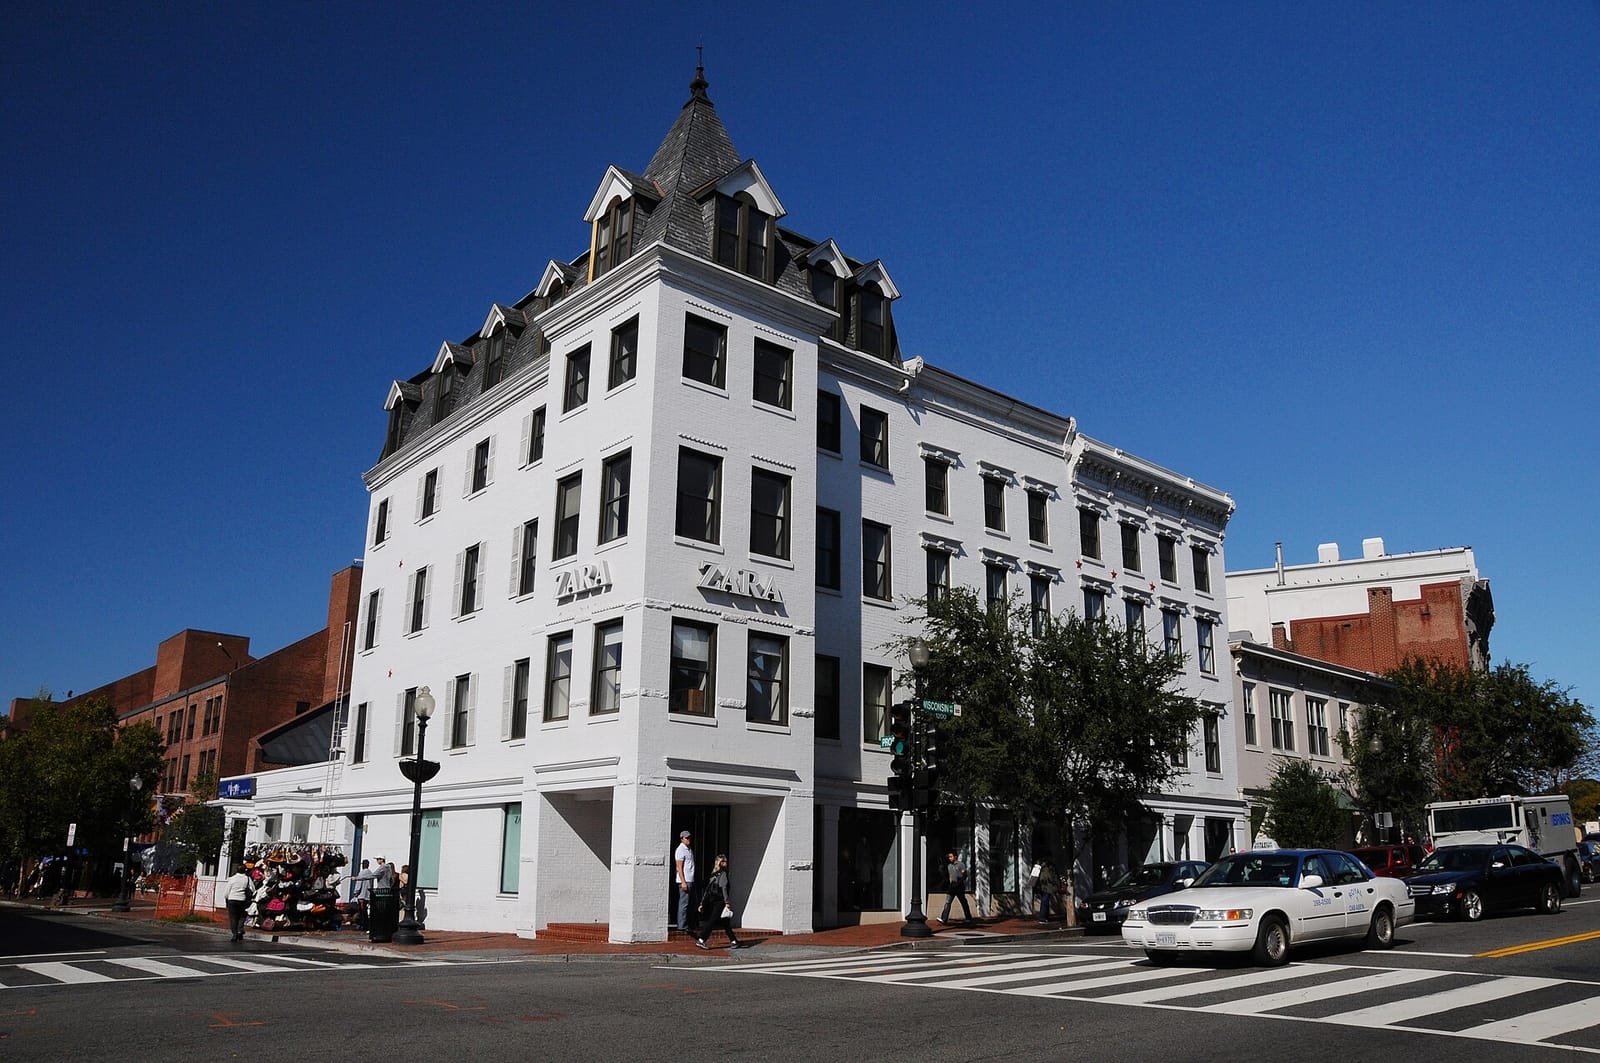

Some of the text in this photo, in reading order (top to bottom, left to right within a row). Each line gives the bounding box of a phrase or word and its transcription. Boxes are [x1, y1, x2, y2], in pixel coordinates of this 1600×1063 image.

[555, 560, 612, 599] ZARA
[697, 560, 784, 603] ZARA
[923, 700, 949, 713] WISCONSIN
[426, 819, 439, 828] ZARA
[1348, 888, 1362, 899] ROYAL
